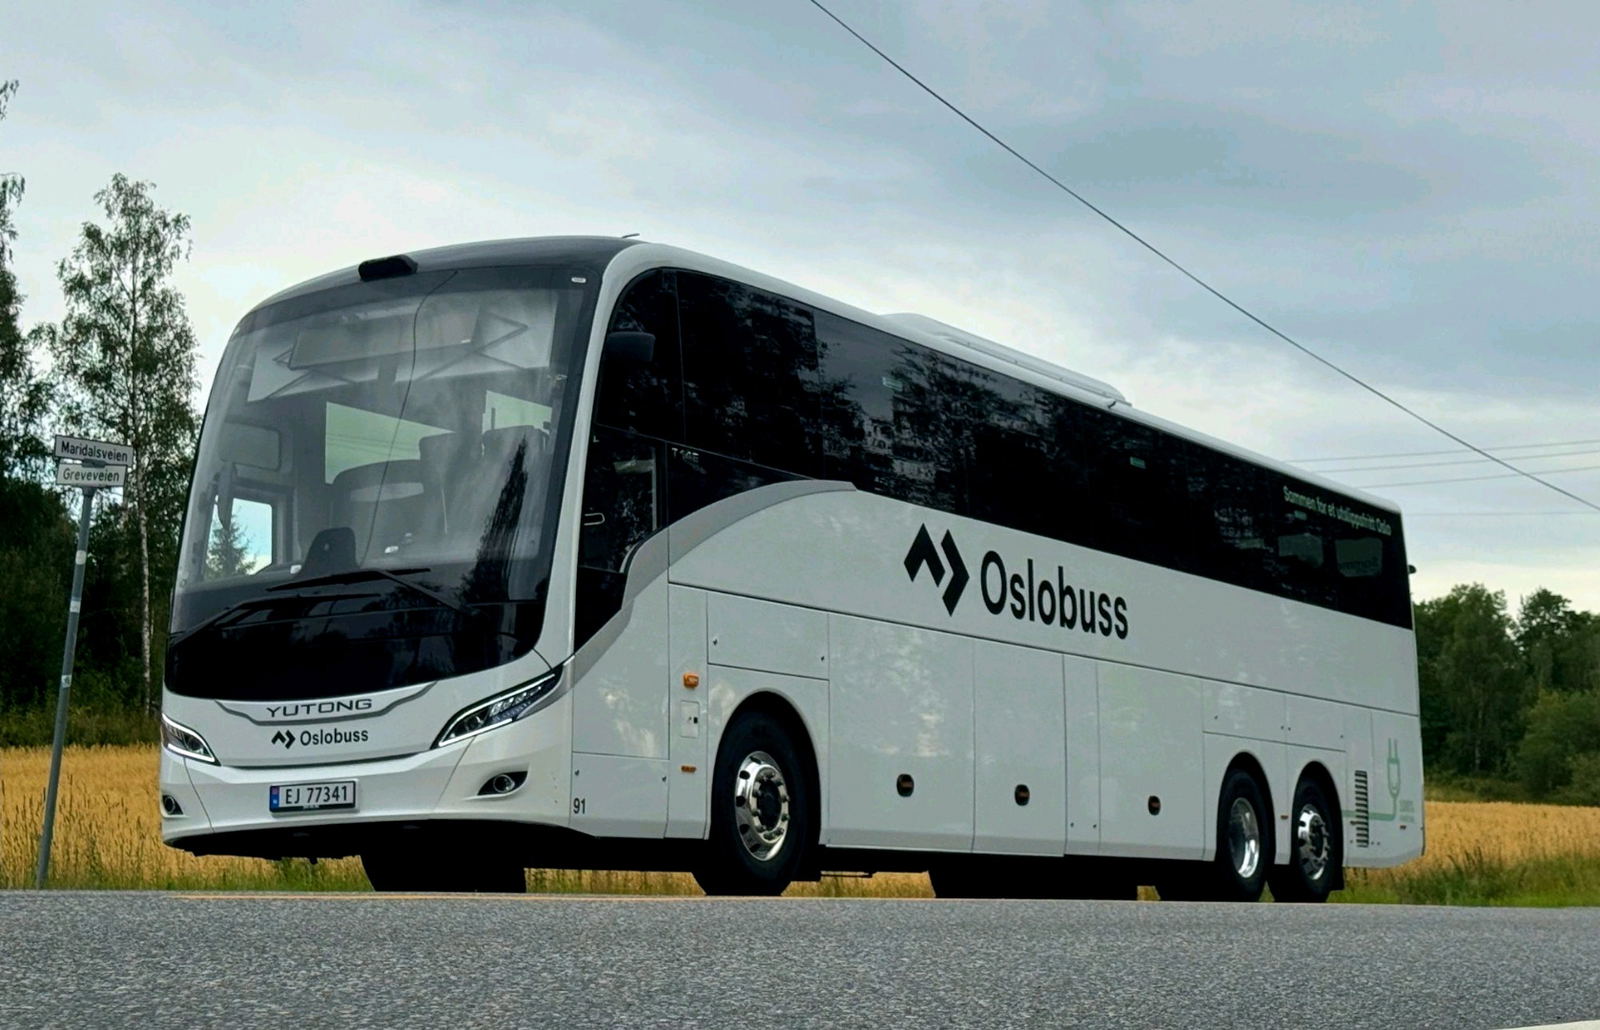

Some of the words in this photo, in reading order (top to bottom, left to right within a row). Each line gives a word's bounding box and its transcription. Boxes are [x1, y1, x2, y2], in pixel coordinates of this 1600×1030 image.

[61, 441, 128, 462] Maridalsveien
[63, 468, 120, 481] Greveveien
[980, 550, 1129, 640] Oslobuss
[266, 699, 373, 718] YUTONG
[300, 728, 369, 746] Oslobuss
[285, 788, 300, 805] EJ
[307, 786, 347, 803] 77341
[573, 798, 586, 814] 91
